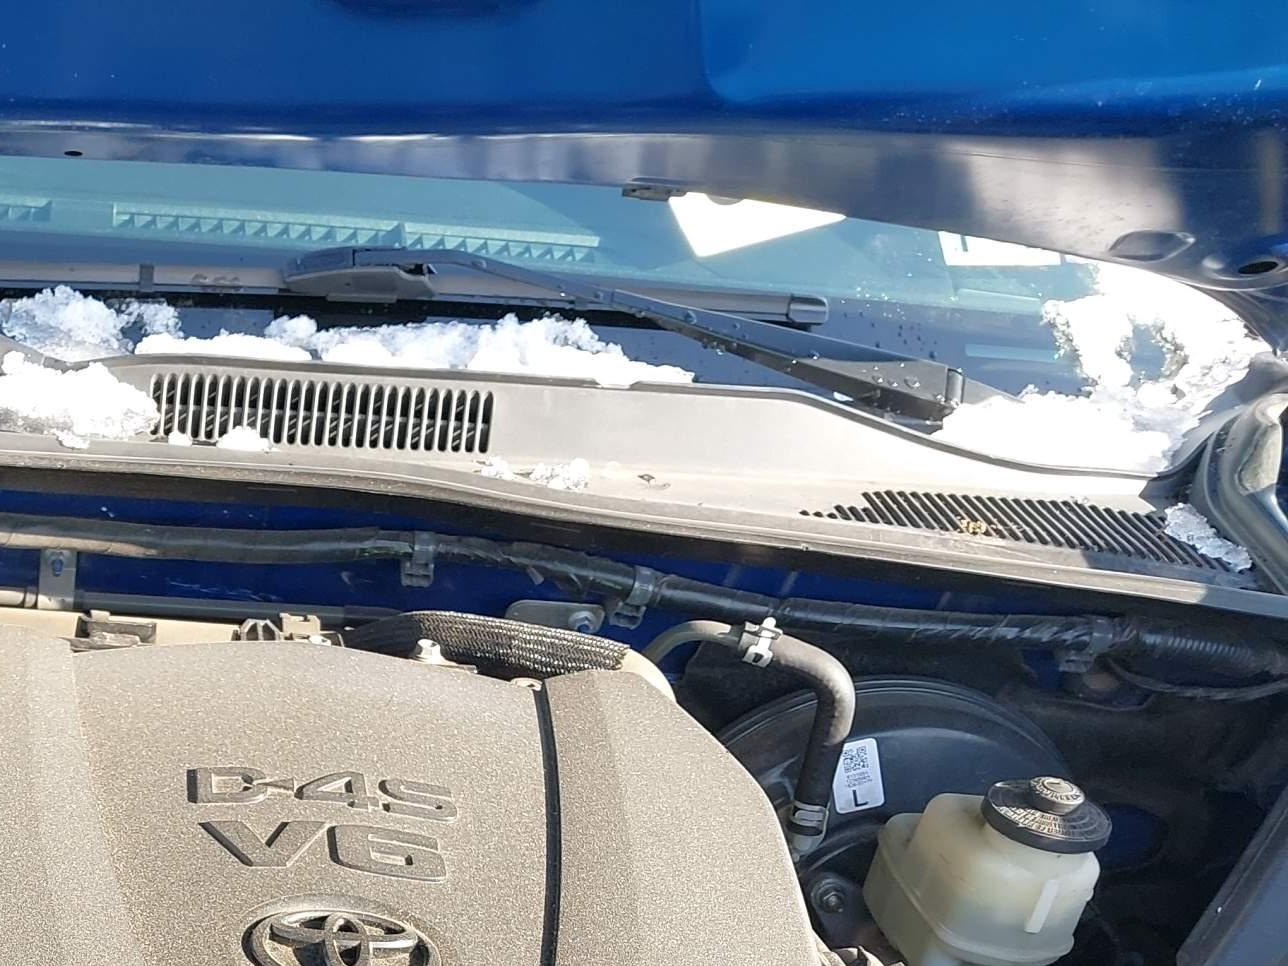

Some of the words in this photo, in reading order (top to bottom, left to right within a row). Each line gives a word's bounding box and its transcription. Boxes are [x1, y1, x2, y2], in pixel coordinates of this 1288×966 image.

[187, 766, 457, 822] D-4S
[852, 789, 869, 808] L
[198, 820, 447, 882] V6
